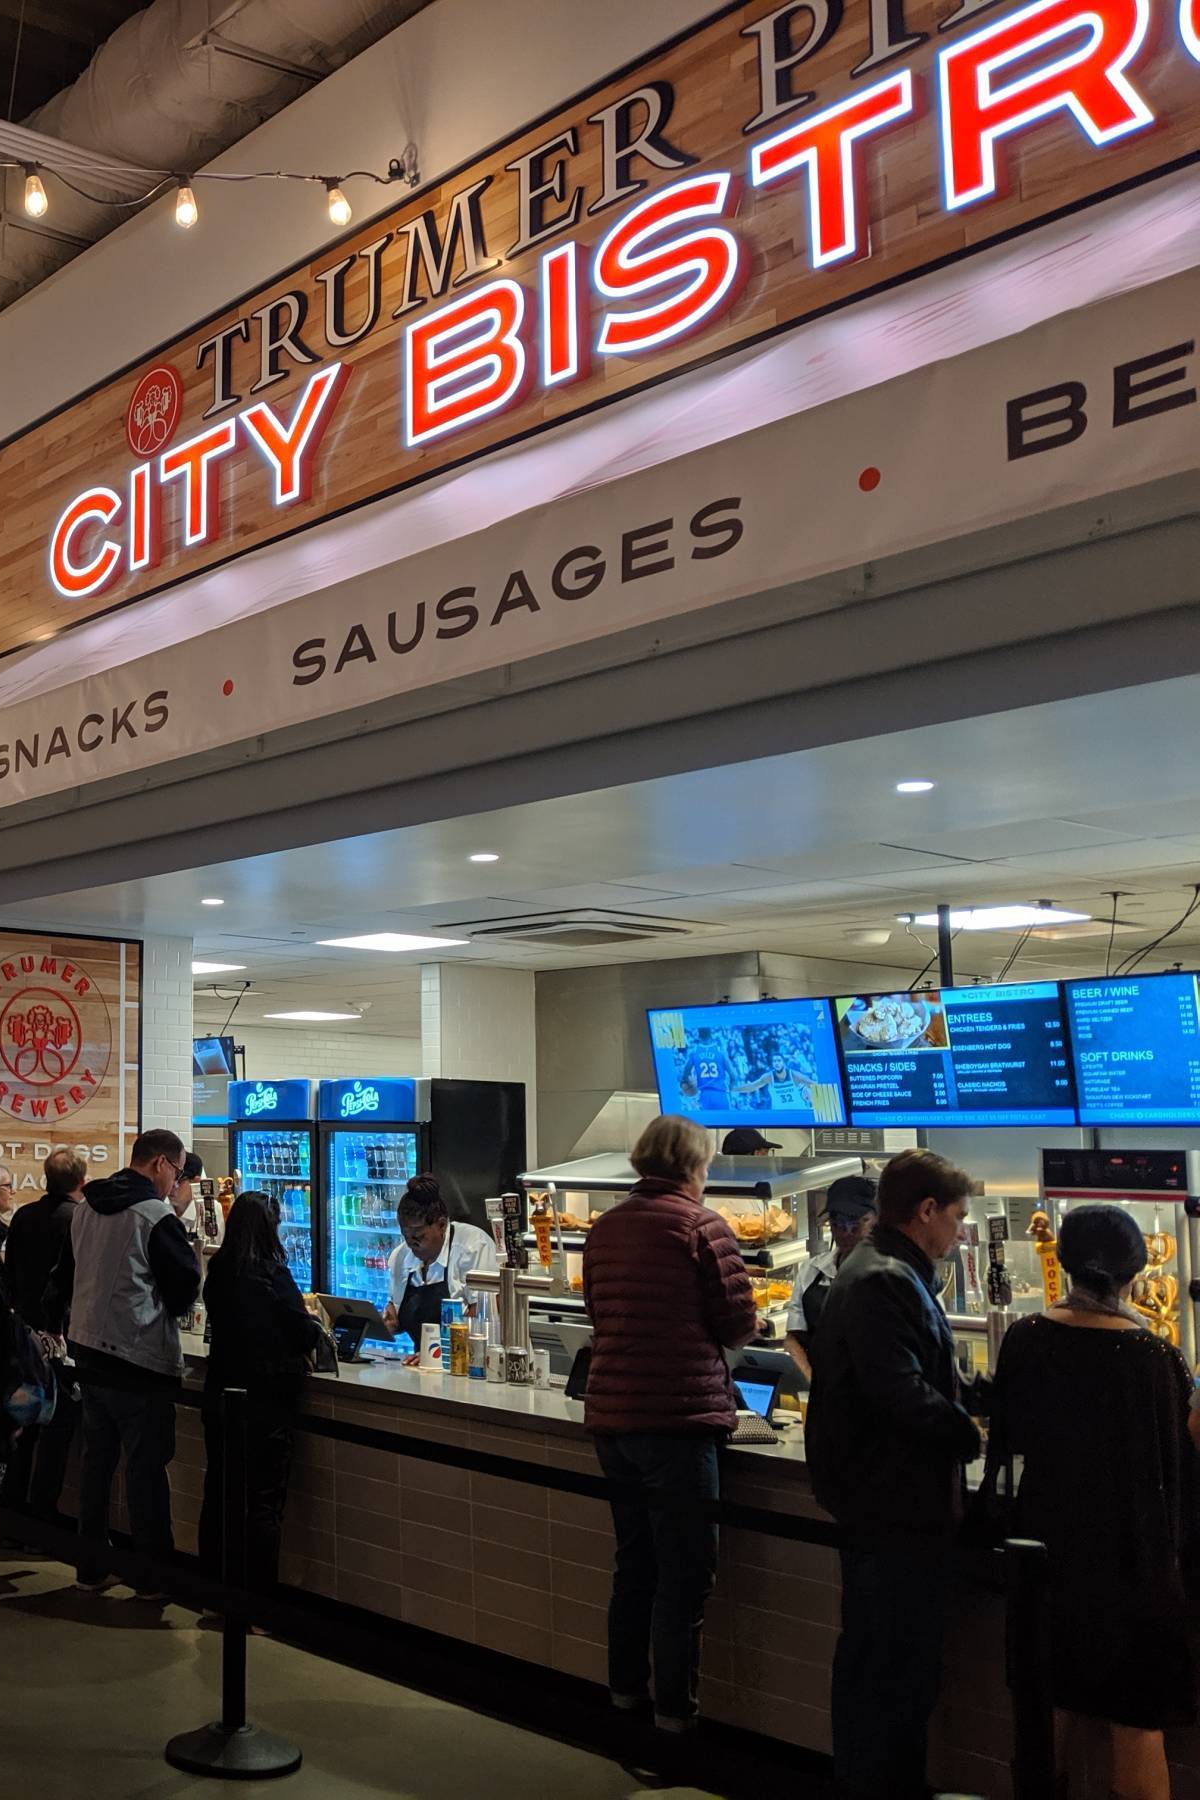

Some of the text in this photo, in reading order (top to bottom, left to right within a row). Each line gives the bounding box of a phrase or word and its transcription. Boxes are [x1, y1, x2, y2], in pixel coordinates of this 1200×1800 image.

[196, 0, 998, 420] TRUMER PI
[49, 0, 1200, 599] CITY BISTR
[291, 497, 744, 686] SAUSAGES
[1007, 339, 1197, 462] BE
[1072, 988, 1102, 999] BEER
[1110, 986, 1140, 997] WINE
[947, 1012, 993, 1024] ENTREES
[976, 1024, 1002, 1032] TENDERS
[1080, 1050, 1153, 1062] SOFT DRINKS
[700, 1062, 719, 1078] 23
[847, 1063, 883, 1073] SNACKS
[889, 1062, 917, 1072] SIDES
[780, 1094, 794, 1104] 32
[34, 1143, 108, 1162] DGS
